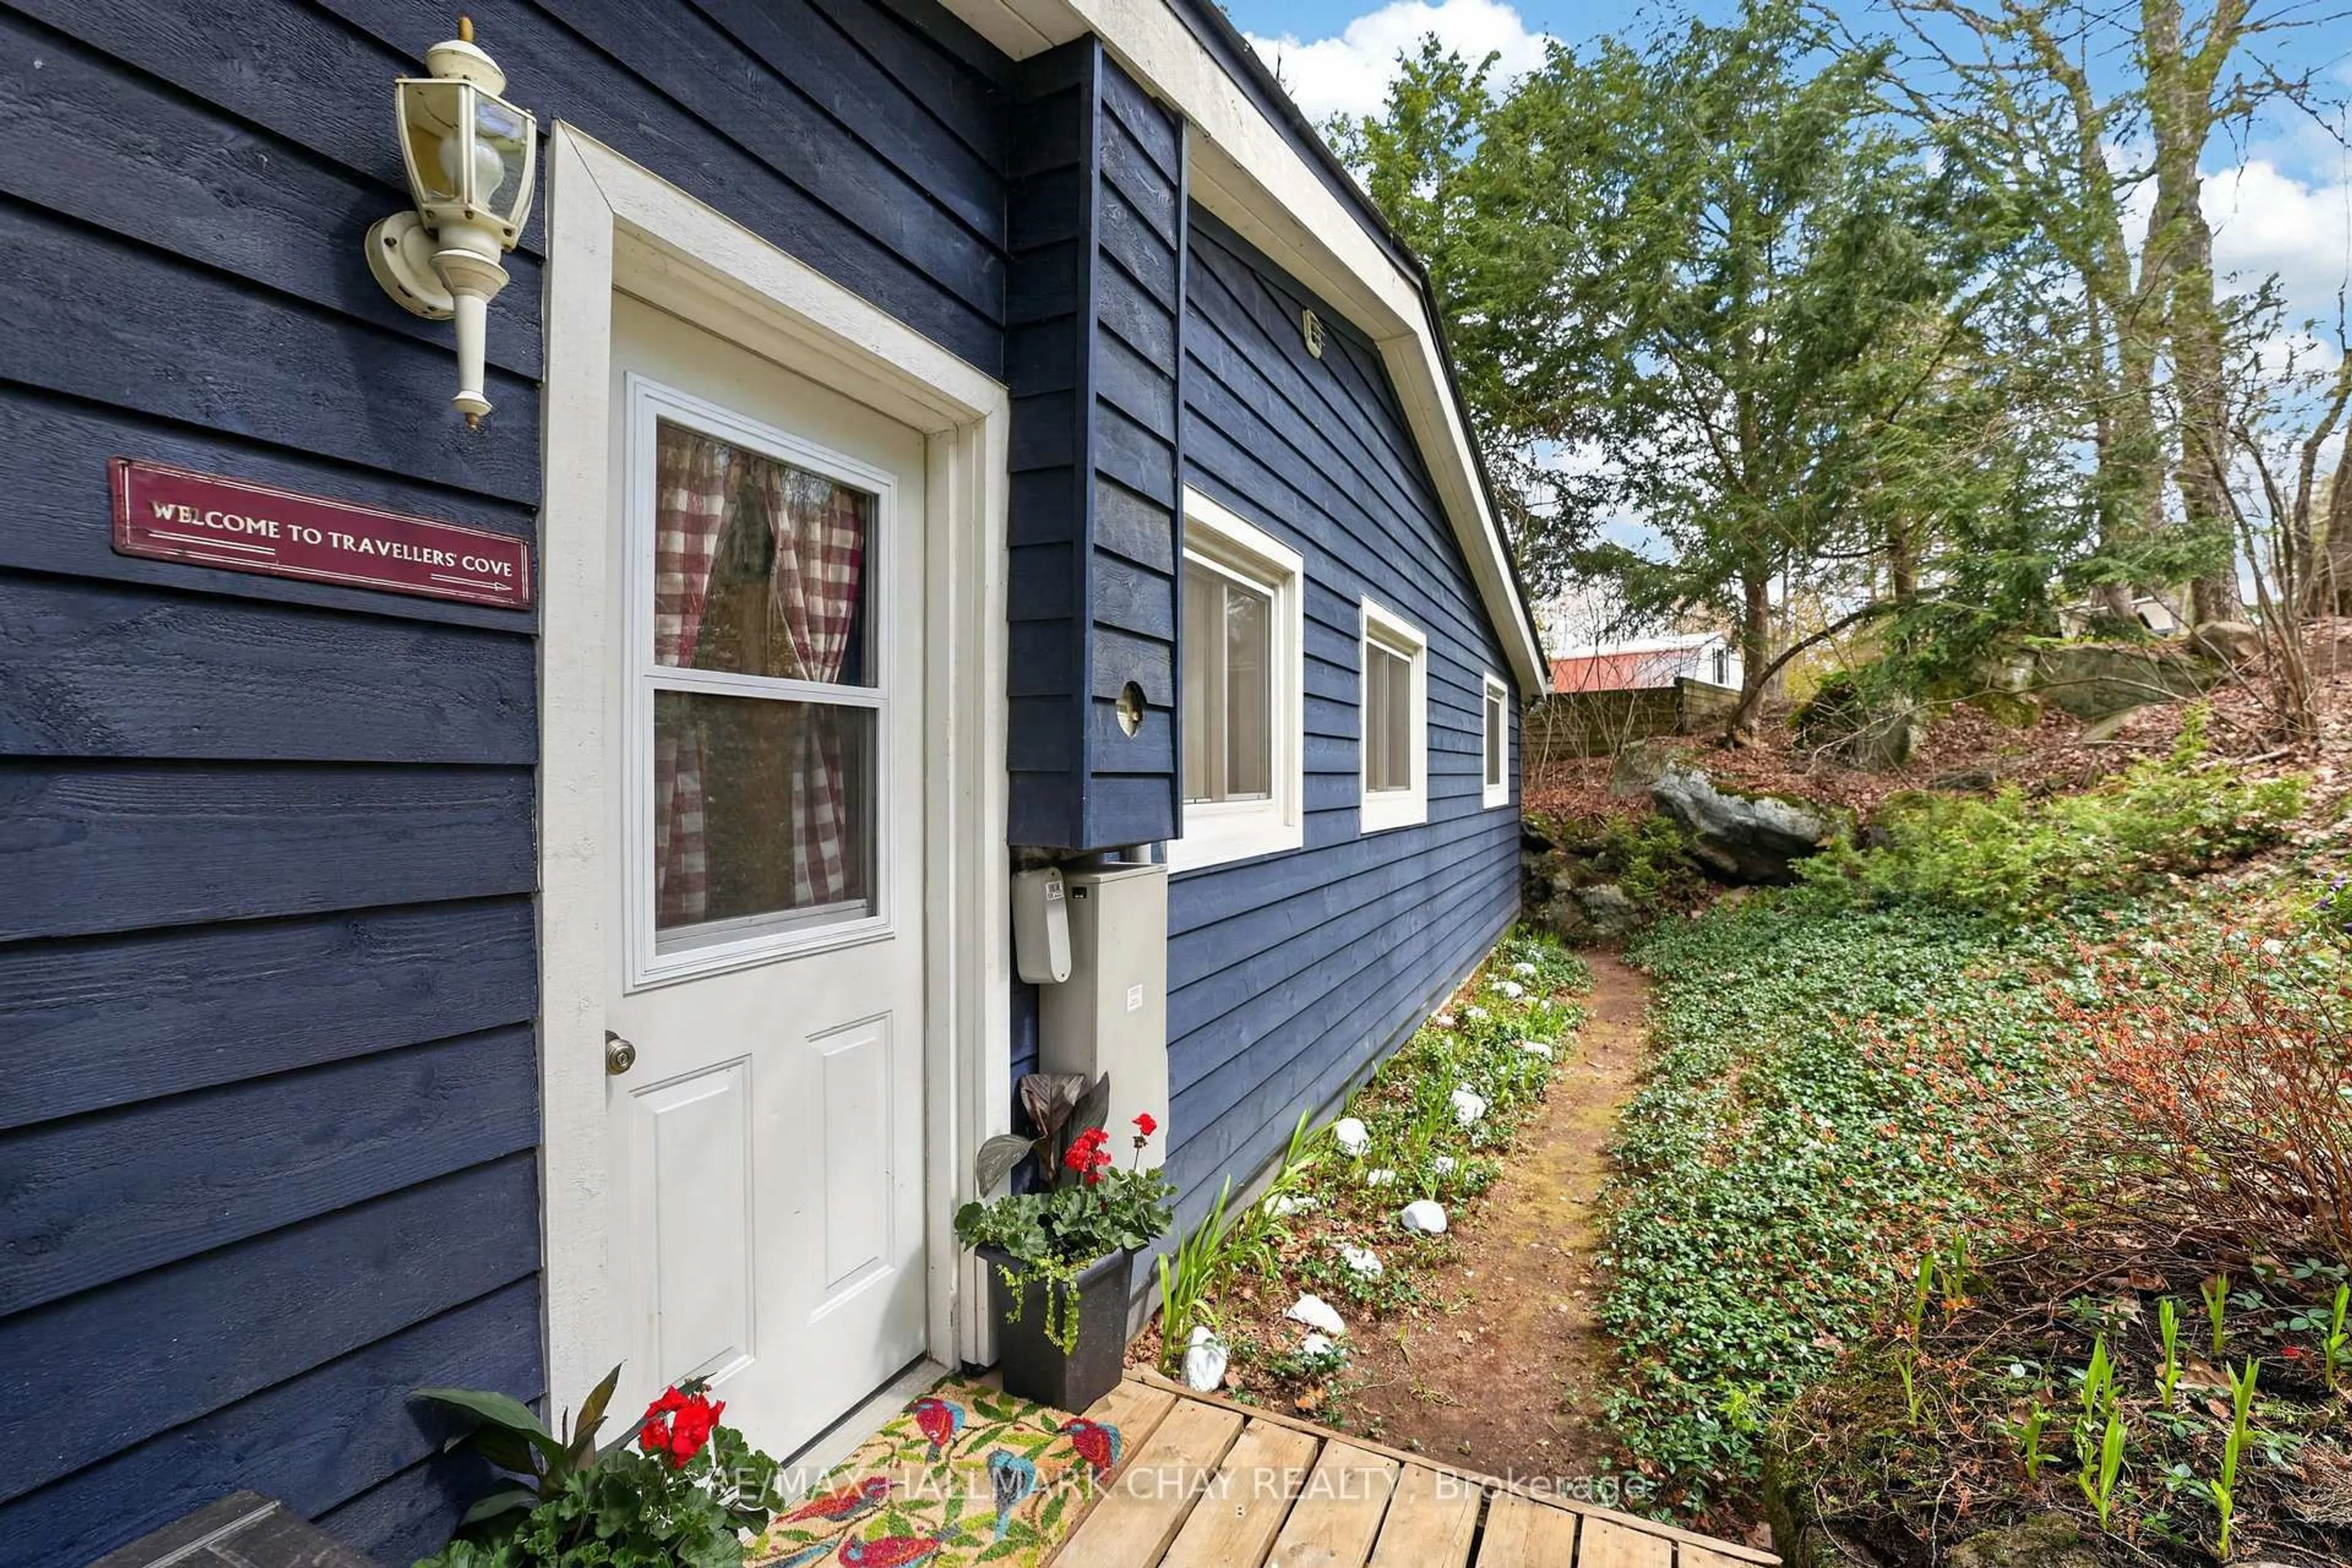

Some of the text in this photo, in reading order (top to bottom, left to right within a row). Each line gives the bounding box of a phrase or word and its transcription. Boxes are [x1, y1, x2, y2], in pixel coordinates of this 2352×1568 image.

[151, 500, 513, 577] WELCOME TO TRAVELLERS' COVE
